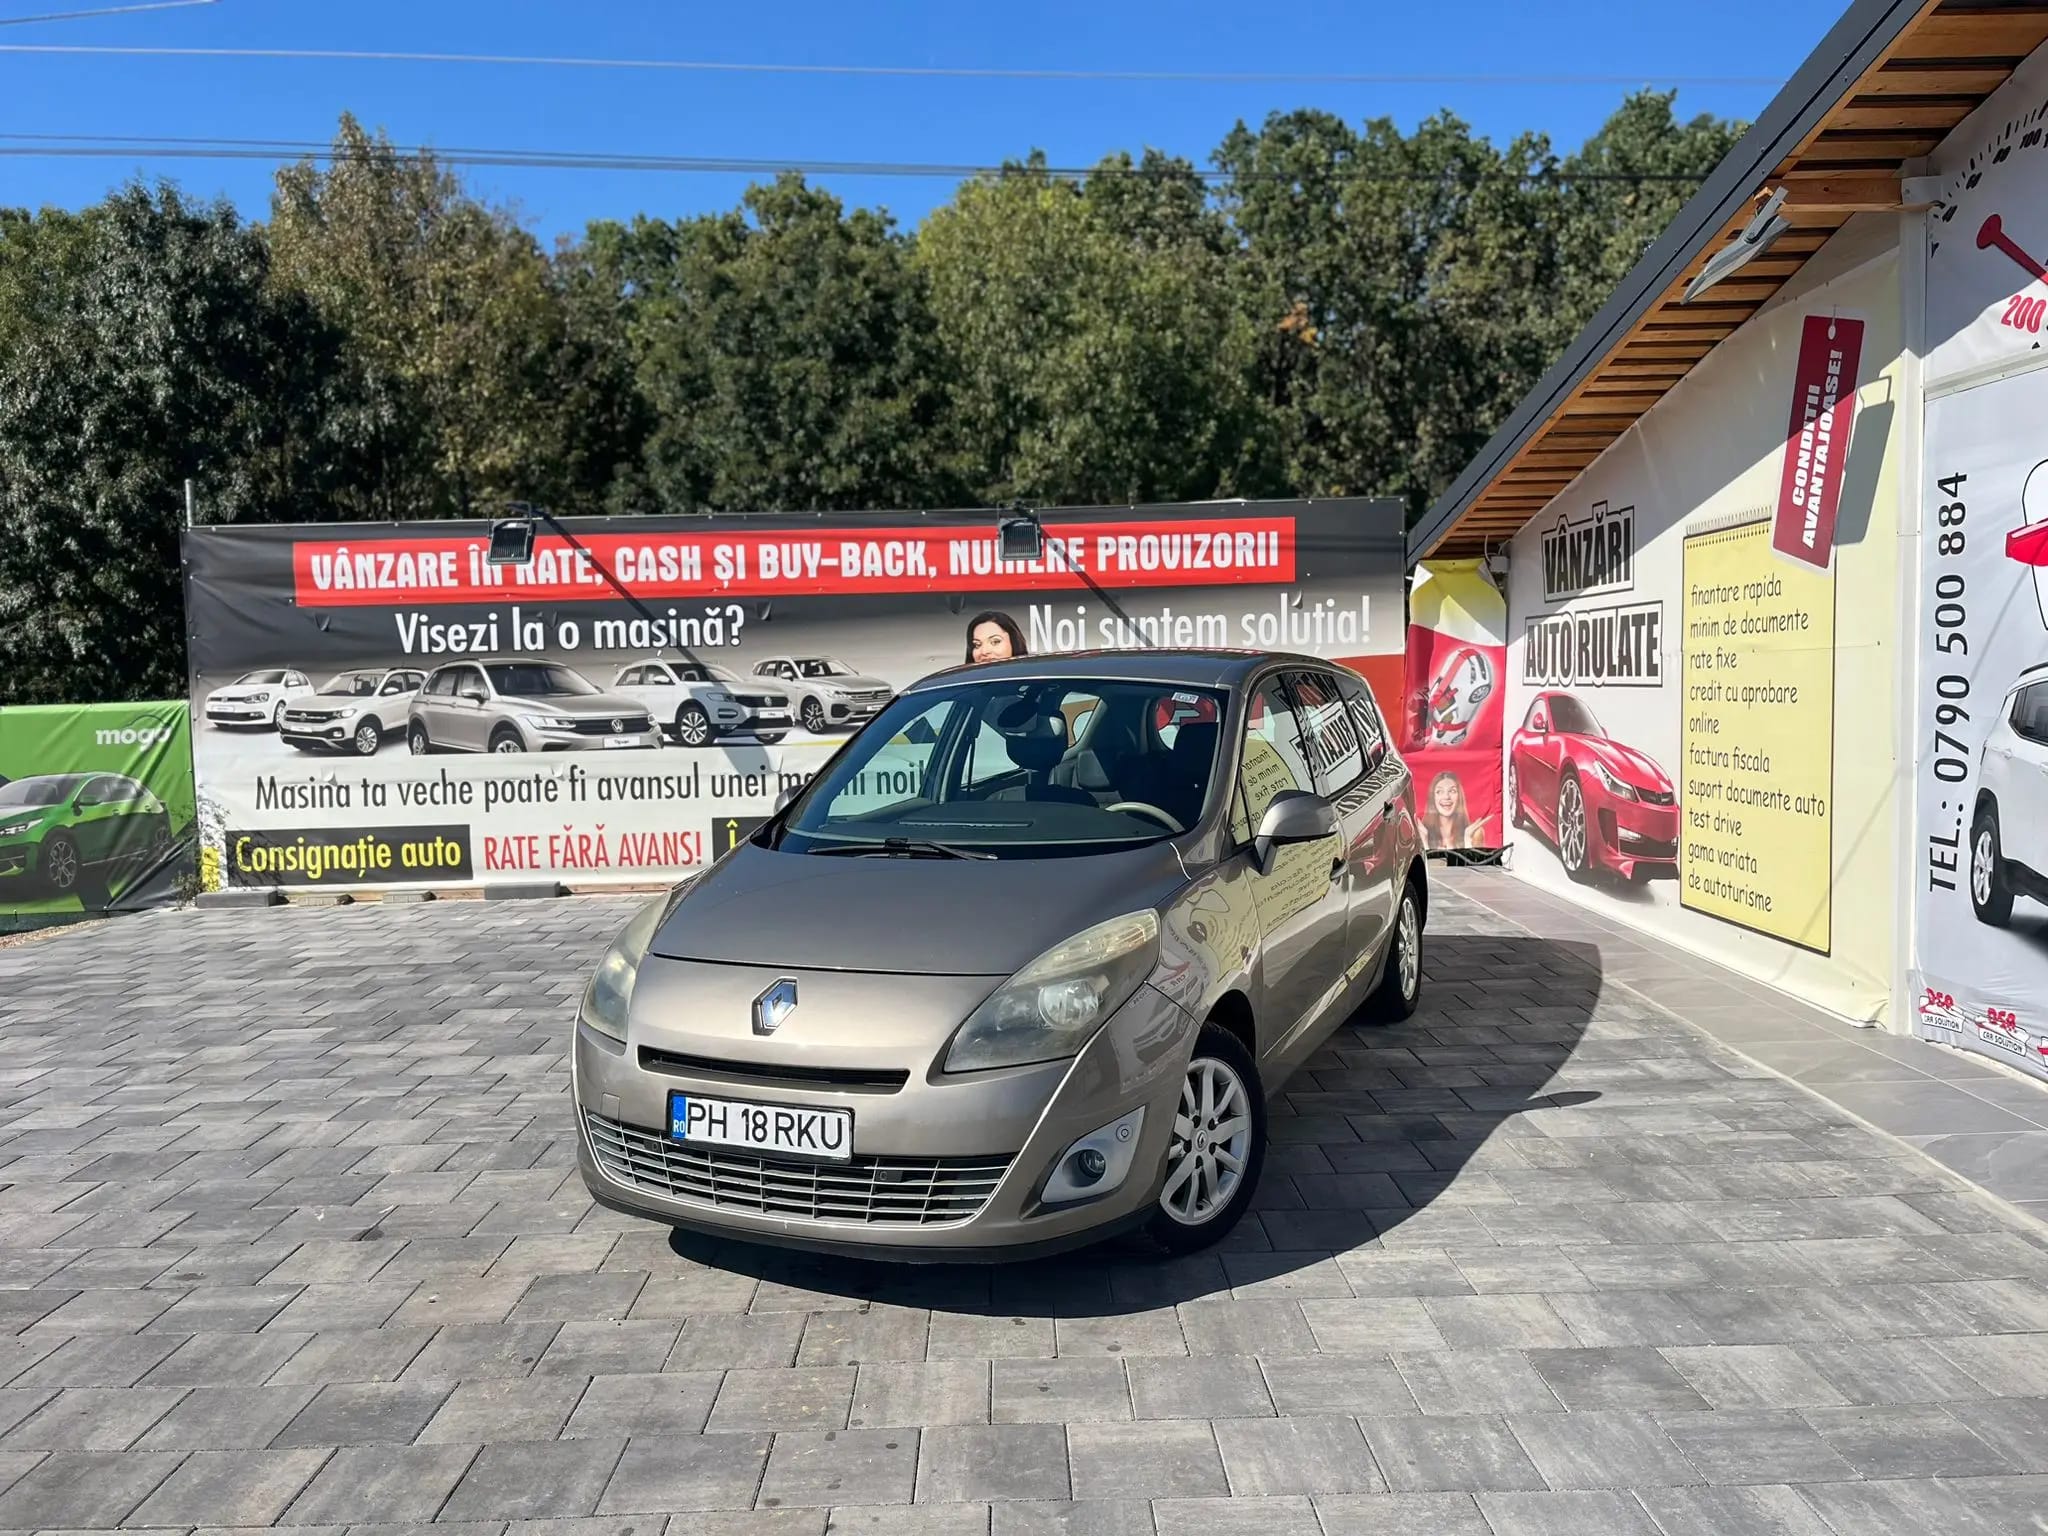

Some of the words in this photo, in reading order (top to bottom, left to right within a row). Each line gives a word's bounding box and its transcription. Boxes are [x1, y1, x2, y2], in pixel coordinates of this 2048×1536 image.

[2001, 294, 2047, 333] 200
[1793, 384, 1821, 507] CONDITII
[1802, 350, 1843, 550] AVANTAJOASE!
[1937, 472, 1968, 557] 884
[311, 547, 458, 590] VÂNZARE
[514, 548, 604, 586] RATE,
[615, 545, 701, 582] CASH
[713, 544, 746, 589] ȘI
[1099, 531, 1279, 572] PROVIZORII
[1544, 510, 1631, 594] VÂNZĂRI
[1691, 584, 1740, 608] finantare
[1743, 572, 1782, 607] rapida
[395, 612, 499, 654] Visezi
[512, 606, 545, 651] la
[557, 620, 580, 651] o
[1029, 605, 1086, 653] Noi
[1099, 607, 1227, 649] suntem
[1241, 592, 1371, 655] soluția!
[1690, 616, 1720, 639] minim
[1723, 613, 1737, 636] de
[1740, 607, 1809, 635] documente
[1935, 573, 1968, 657] 500
[1525, 620, 1573, 679] AUTO
[1577, 611, 1659, 679] RULATE
[1690, 650, 1713, 670] rate
[1716, 646, 1738, 671] fixe
[1690, 680, 1722, 702] credit
[1725, 684, 1739, 703] cu
[1741, 680, 1798, 710] aprobare
[1689, 711, 1720, 734] online
[1934, 674, 1971, 784] 0790
[1690, 742, 1729, 768] factura
[1732, 746, 1770, 773] fiscala
[256, 775, 351, 810] Masina
[360, 777, 387, 808] ta
[398, 768, 473, 806] veche
[484, 774, 559, 813] poate
[568, 764, 587, 802] fi
[598, 761, 700, 801] avansul
[710, 764, 767, 798] unei
[1689, 778, 1723, 804] suport
[1726, 779, 1791, 812] documente
[1794, 793, 1826, 817] auto
[1689, 807, 1711, 829] test
[1714, 811, 1743, 837] drive
[236, 834, 392, 879] Consignație
[401, 835, 462, 868] auto
[484, 836, 540, 871] RATE
[549, 824, 610, 869] FĂRĂ
[618, 831, 703, 867] AVANS!
[1688, 843, 1715, 864] gama
[1717, 848, 1758, 875] variata
[1688, 868, 1701, 891] de
[1703, 877, 1773, 912] autoturisme
[687, 1102, 728, 1139] PH
[741, 1107, 768, 1143] 18
[774, 1112, 843, 1150] RKU
